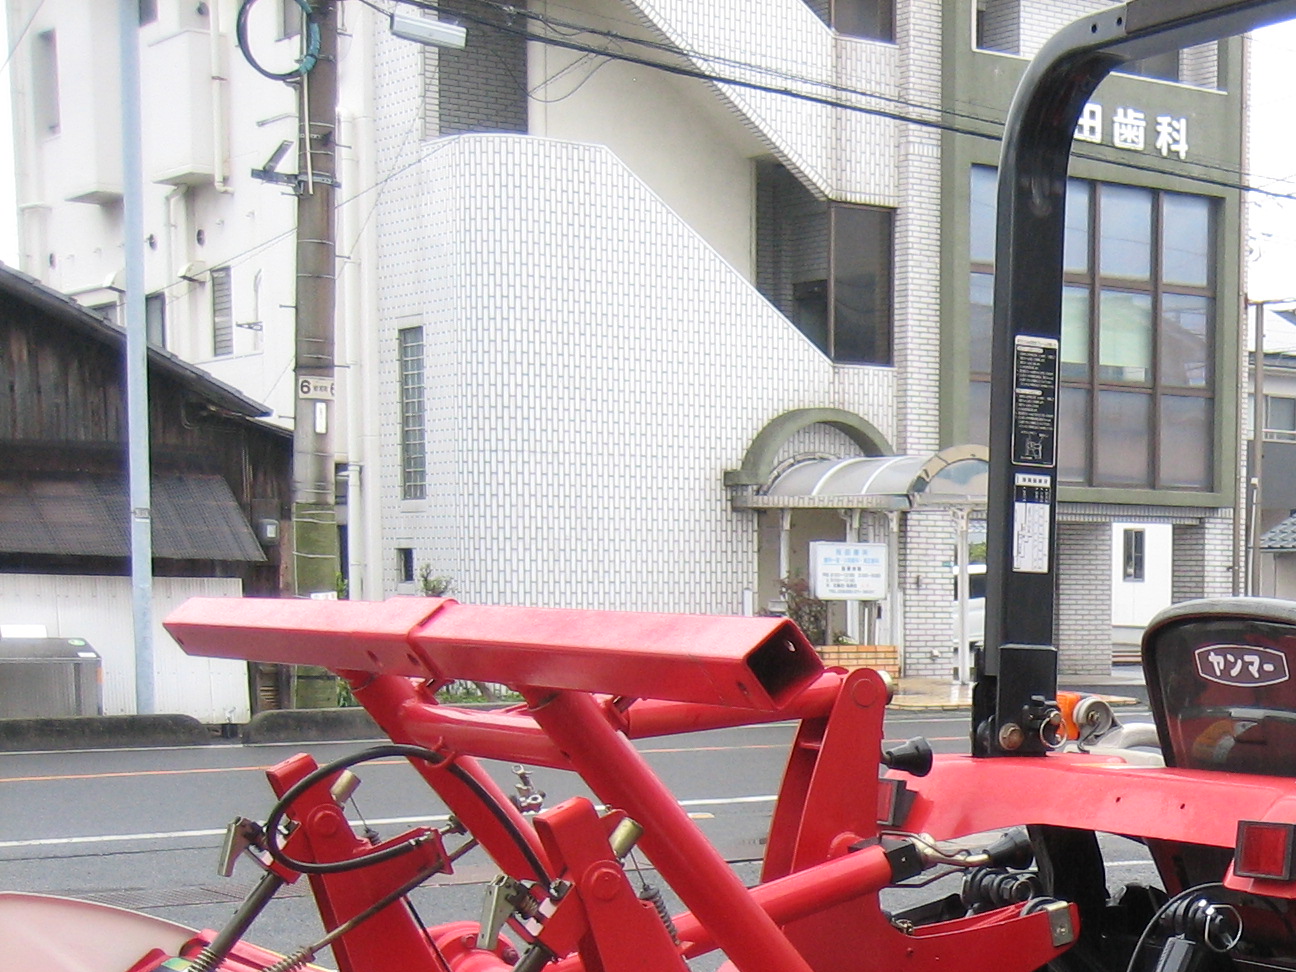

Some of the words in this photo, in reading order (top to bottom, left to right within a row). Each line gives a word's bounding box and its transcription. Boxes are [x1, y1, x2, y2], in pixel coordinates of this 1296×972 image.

[300, 379, 312, 395] 6
[1207, 651, 1275, 679] ヤンマー
